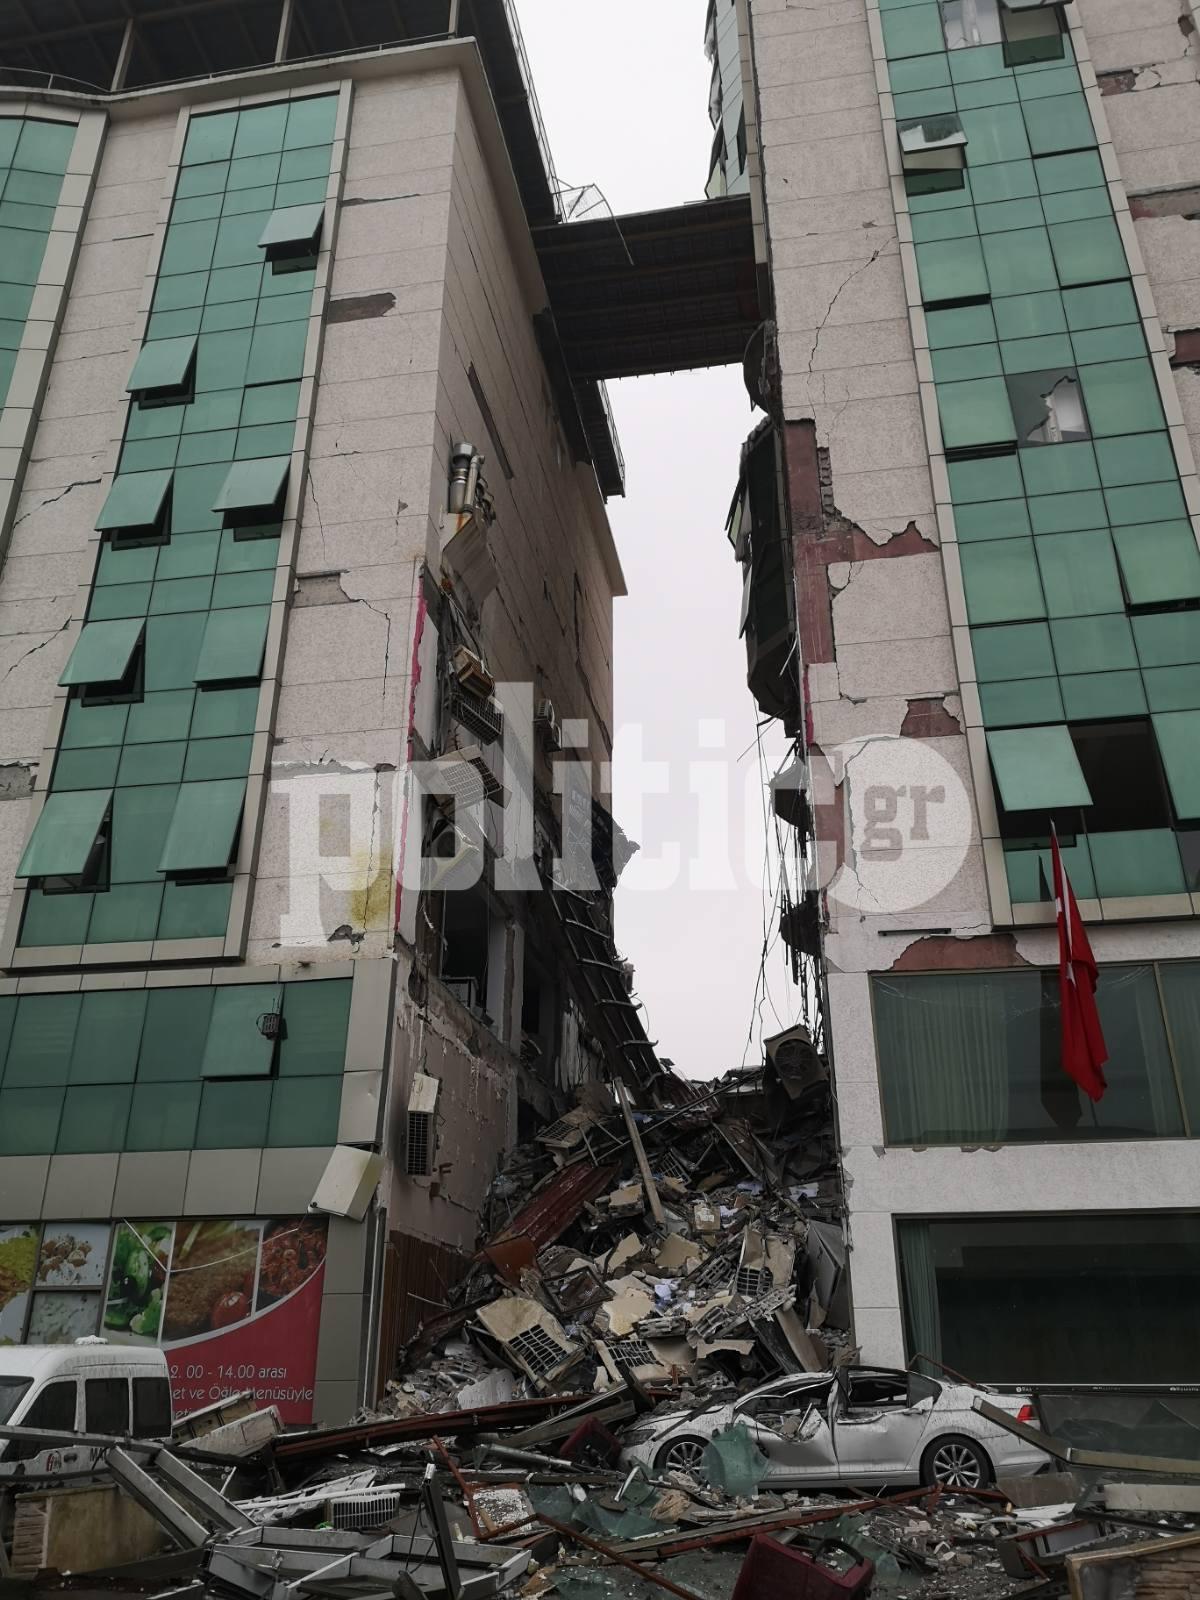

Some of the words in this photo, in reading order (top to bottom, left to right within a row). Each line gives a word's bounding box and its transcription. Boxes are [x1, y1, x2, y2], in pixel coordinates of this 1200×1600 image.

[186, 1365, 203, 1379] 00
[218, 1365, 254, 1379] 14.00
[258, 1367, 287, 1379] arası
[190, 1389, 203, 1400] ve
